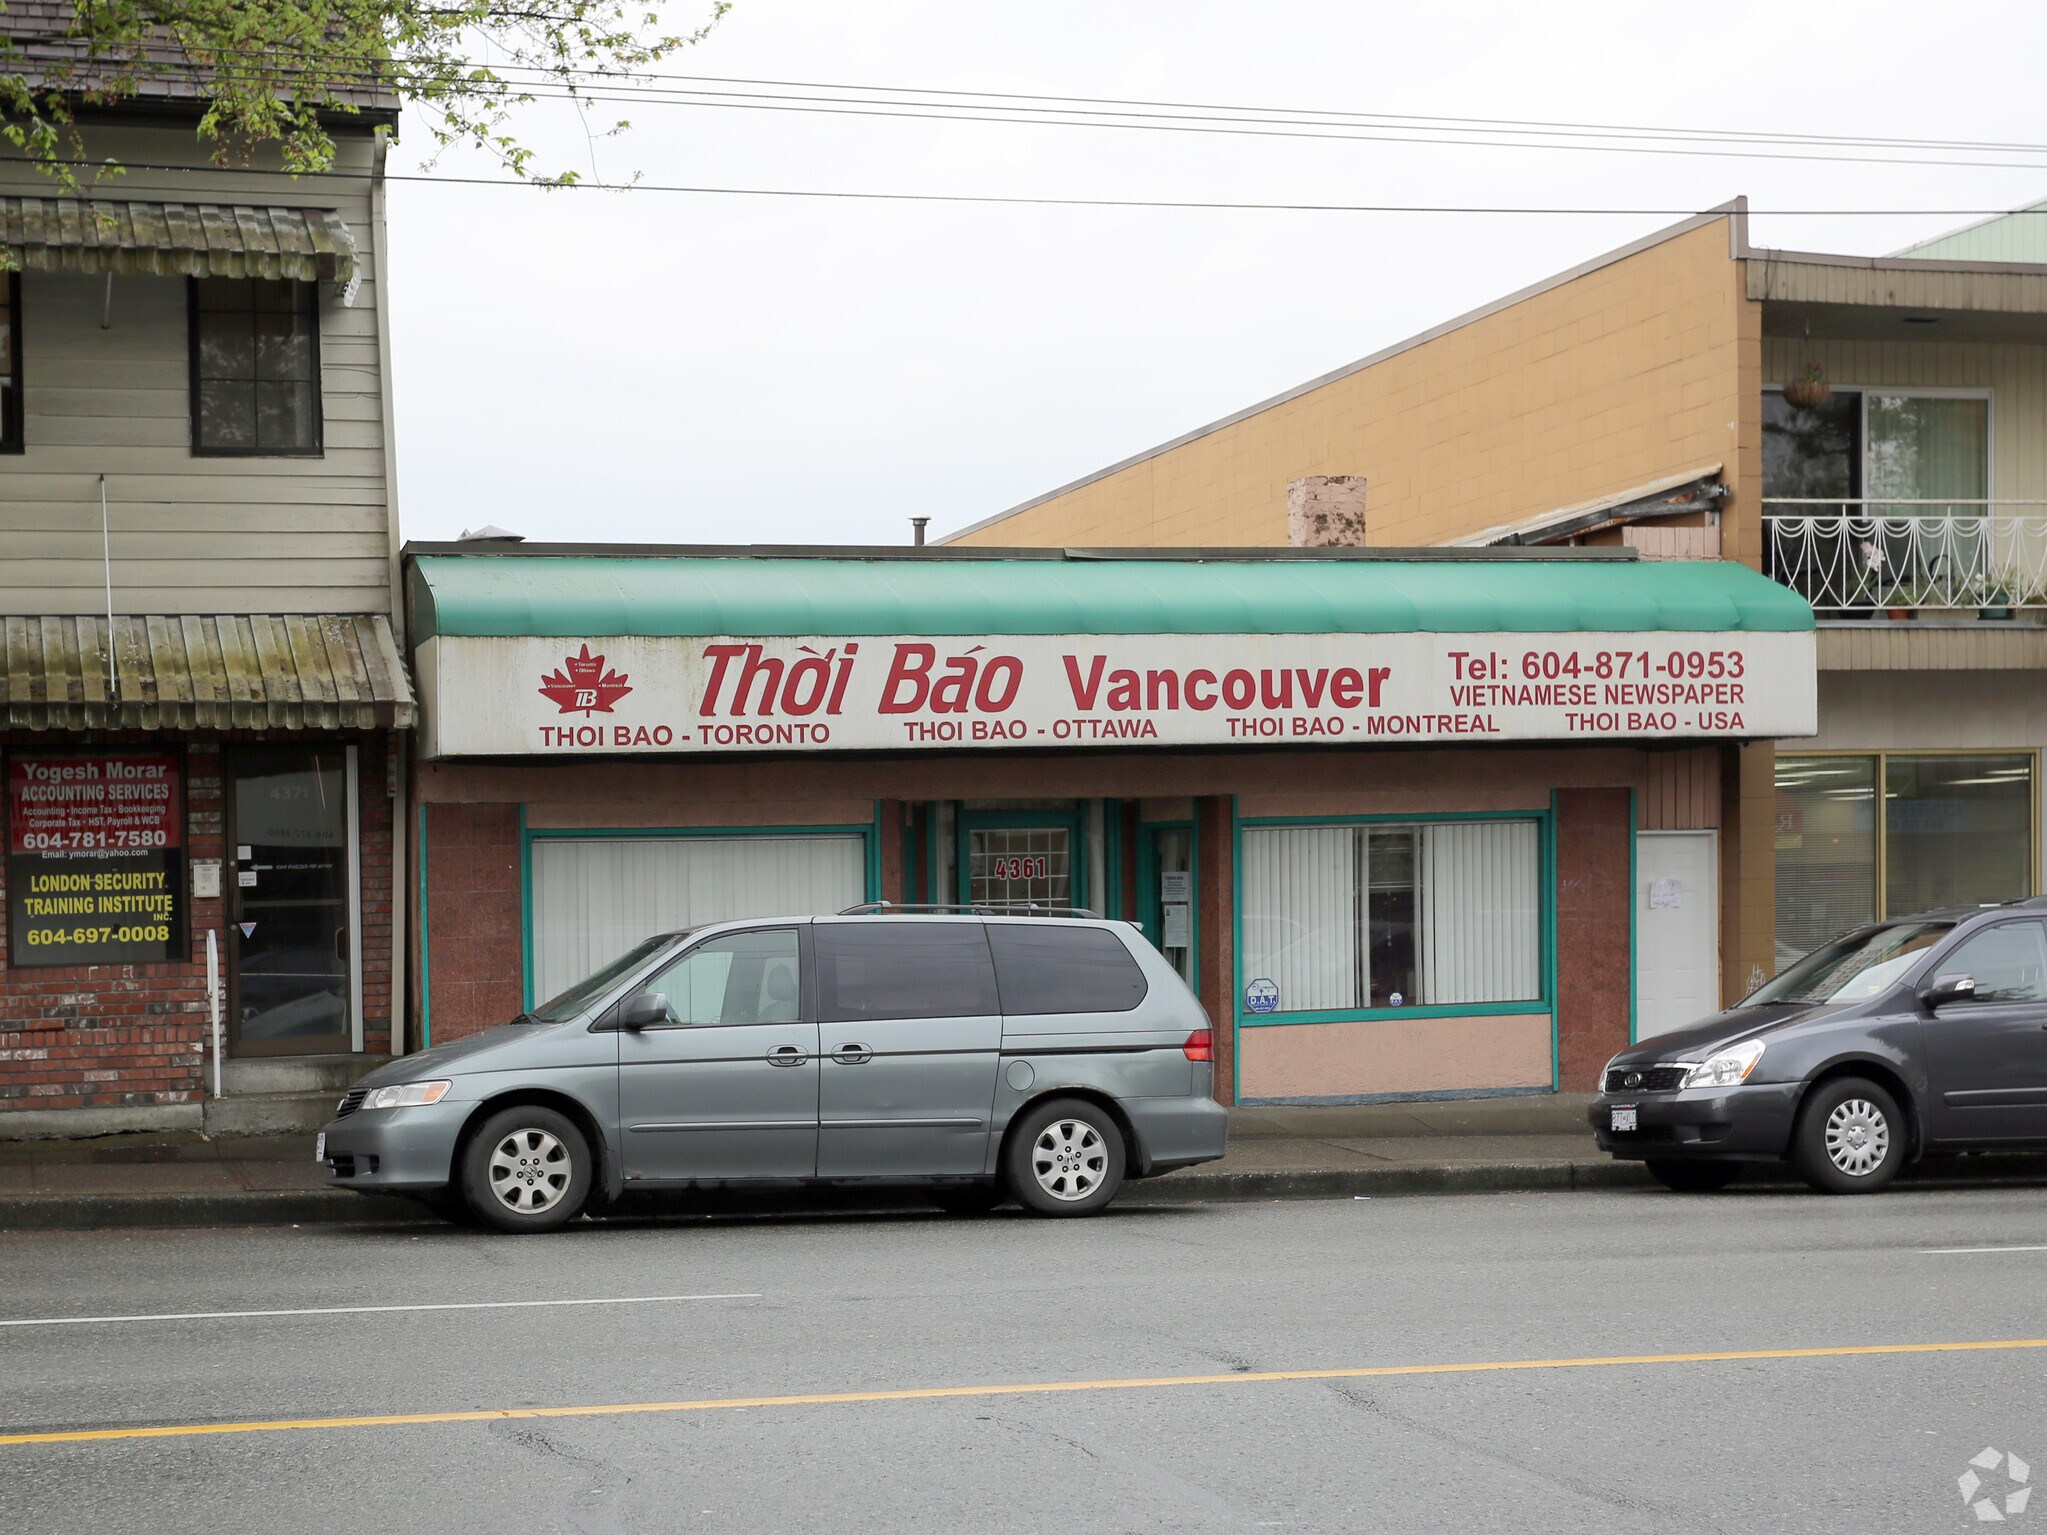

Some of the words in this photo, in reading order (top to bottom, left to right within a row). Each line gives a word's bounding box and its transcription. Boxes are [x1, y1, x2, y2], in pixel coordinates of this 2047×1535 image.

[1449, 651, 1509, 680] Tel:
[1522, 651, 1745, 680] 604-871-0953
[700, 642, 859, 717] Thời
[879, 644, 1024, 714] Báo
[1063, 655, 1391, 711] Vancouver
[1450, 684, 1597, 707] VIETNAMESE
[1605, 683, 1744, 705] NEWSPAPER
[904, 722, 964, 741] THOI
[973, 720, 1027, 740] BAO
[1053, 719, 1157, 739] OTTAWA
[1229, 718, 1284, 736] THOI
[1293, 717, 1344, 736] BAO
[1368, 714, 1500, 734] MONTREAL
[1567, 713, 1619, 730] THOI
[1628, 712, 1678, 730] BAO
[1699, 711, 1744, 729] USA
[539, 726, 604, 746] THOI
[614, 725, 673, 746] BAO
[699, 723, 830, 745] TORONTO
[23, 762, 98, 784] Yogesh
[106, 762, 166, 779] Morar
[22, 786, 104, 801] ACCOUNTING
[108, 784, 169, 799] SERVICES
[270, 787, 308, 799] 4371
[23, 807, 65, 816] Accounting
[71, 806, 98, 815] Income
[100, 806, 112, 814] Tax
[119, 805, 165, 814] Bookkeeping
[29, 819, 65, 828] Corporate
[107, 817, 132, 826] Payroll
[142, 816, 160, 824] WCB
[23, 831, 166, 849] 604-781-7580
[69, 849, 148, 859] ymorar@yahoo.com
[995, 857, 1045, 880] 4361
[31, 875, 90, 892] LONDON
[95, 873, 165, 890] SECURITY
[24, 897, 94, 915] TRAINING
[99, 895, 173, 913] INSTITUTE
[154, 913, 172, 921] INC.
[27, 926, 169, 945] 604-697-0008
